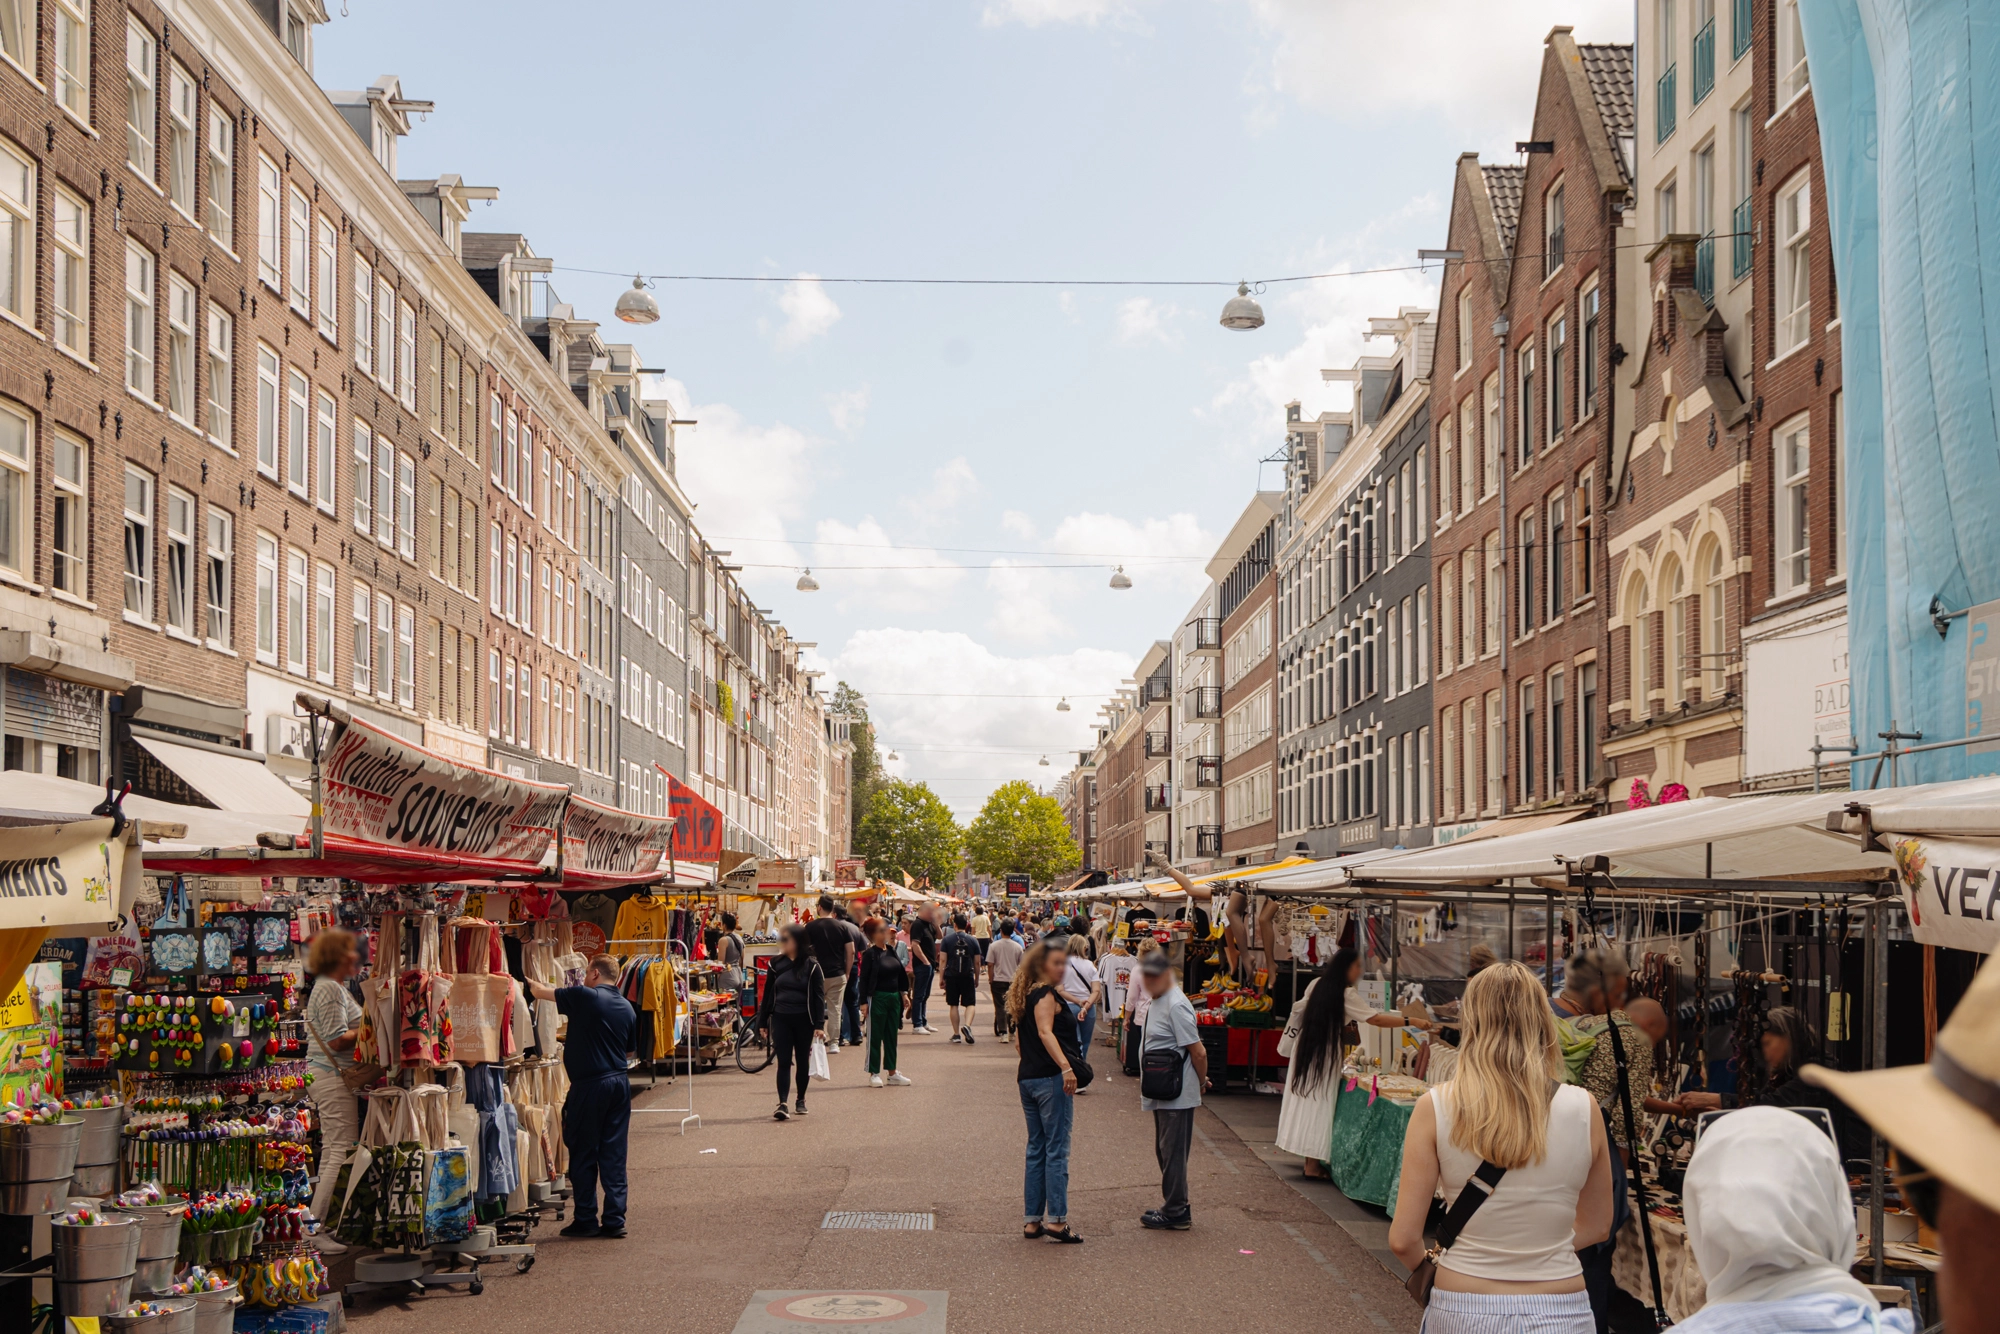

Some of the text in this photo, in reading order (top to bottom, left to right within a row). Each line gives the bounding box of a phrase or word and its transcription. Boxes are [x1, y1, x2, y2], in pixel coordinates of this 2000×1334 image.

[329, 736, 515, 854] Kruithof souvenirs
[1342, 824, 1374, 844] VINTAGE
[585, 821, 645, 873] souvenirs
[674, 849, 717, 859] oiletten
[1284, 1025, 1302, 1039] JS
[454, 1041, 487, 1049] msterda
